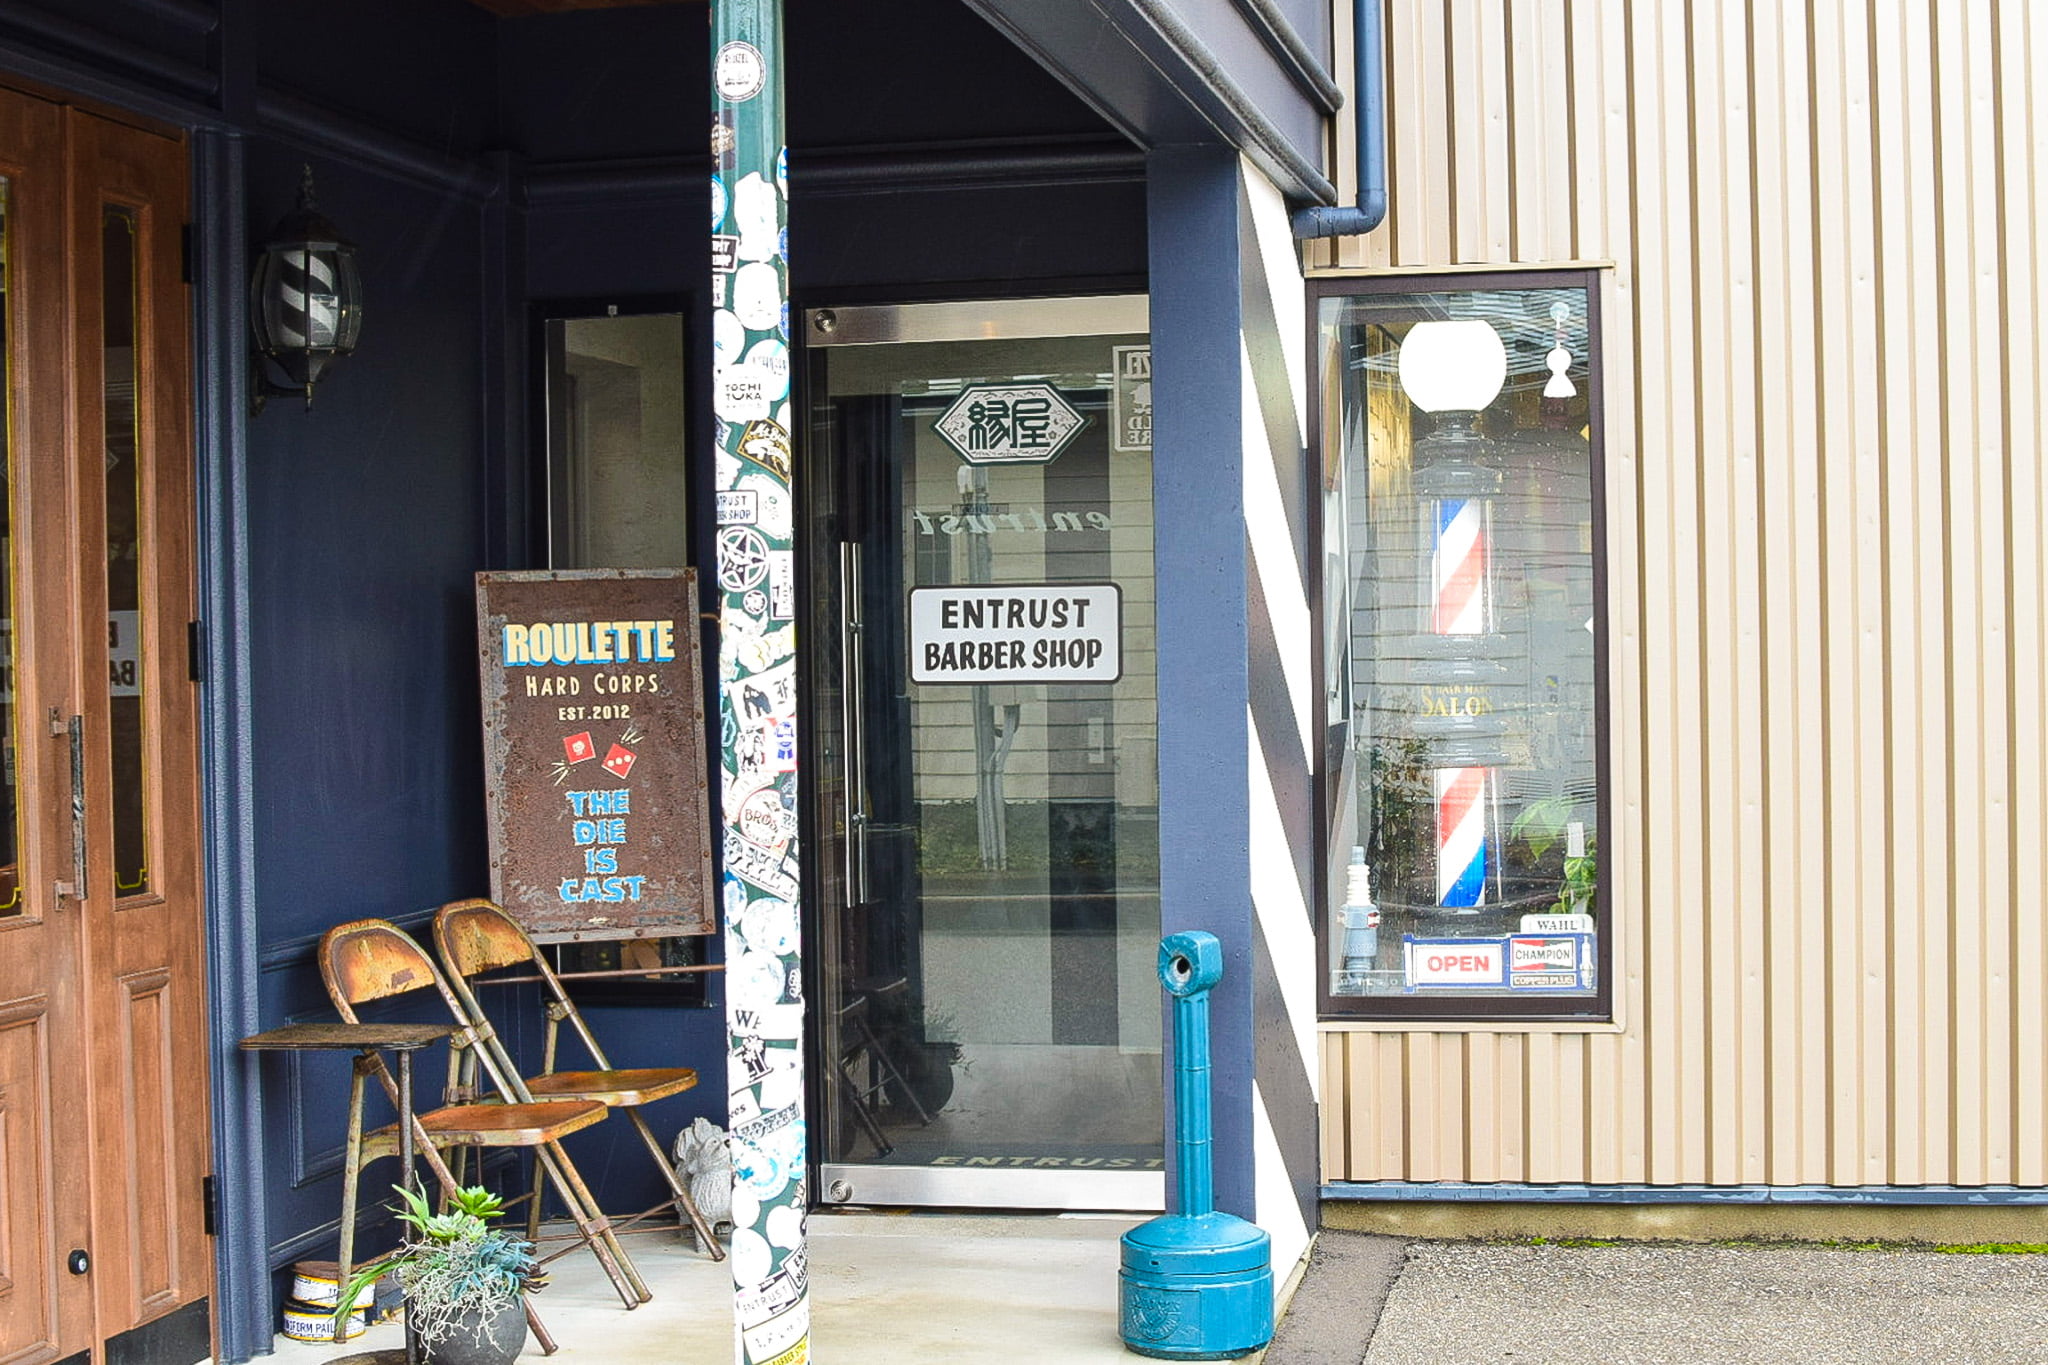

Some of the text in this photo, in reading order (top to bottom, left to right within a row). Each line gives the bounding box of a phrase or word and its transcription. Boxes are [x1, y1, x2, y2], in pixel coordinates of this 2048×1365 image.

[725, 383, 761, 391] TOCHI
[941, 598, 1091, 630] ENTRUST
[503, 619, 676, 667] ROULETTE
[924, 638, 1103, 671] BARBER SHOP
[525, 672, 660, 697] HARD CORPS
[558, 704, 631, 722] EST.2012
[566, 789, 631, 816] THE
[573, 818, 627, 845] DIE
[585, 848, 619, 875] IS
[559, 875, 647, 904] CAST
[1537, 920, 1578, 931] WAHL
[1427, 956, 1490, 973] OPEN
[1515, 949, 1571, 961] CHAMPION
[930, 1156, 1165, 1167] ENTRUST
[315, 1323, 335, 1333] PAIL
